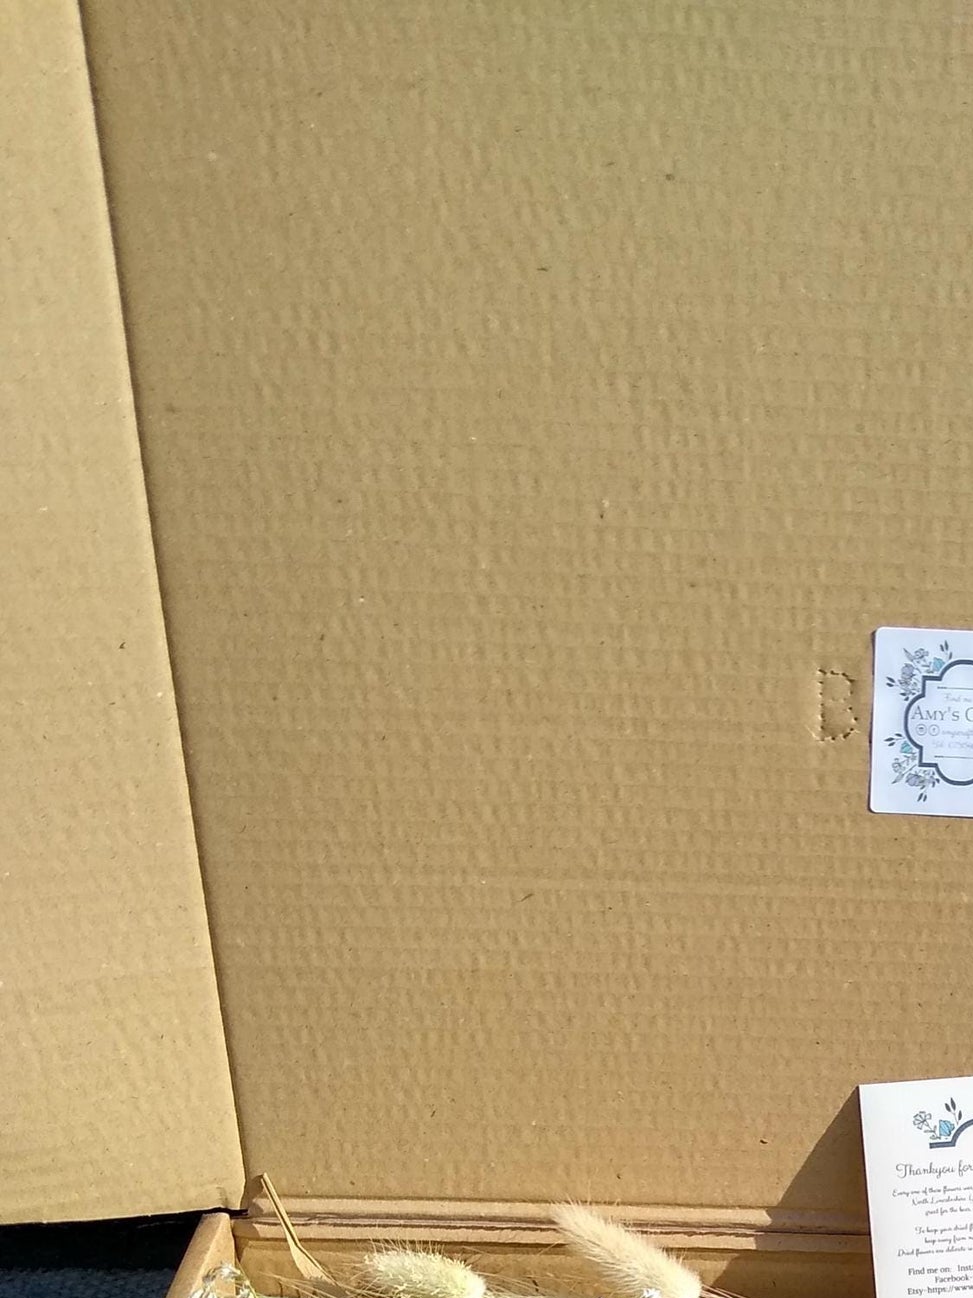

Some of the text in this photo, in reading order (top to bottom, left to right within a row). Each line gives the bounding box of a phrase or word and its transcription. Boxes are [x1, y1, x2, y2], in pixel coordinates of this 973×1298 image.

[910, 705, 960, 722] AMY'S
[896, 1162, 955, 1179] Thankyou
[922, 1187, 928, 1195] of
[943, 1185, 962, 1194] flowers
[940, 1207, 948, 1216] for
[926, 1226, 938, 1234] keep
[924, 1237, 936, 1246] keep
[954, 1234, 966, 1244] from
[897, 1248, 914, 1257] Dried
[916, 1248, 934, 1258] flowers
[908, 1267, 925, 1276] Find
